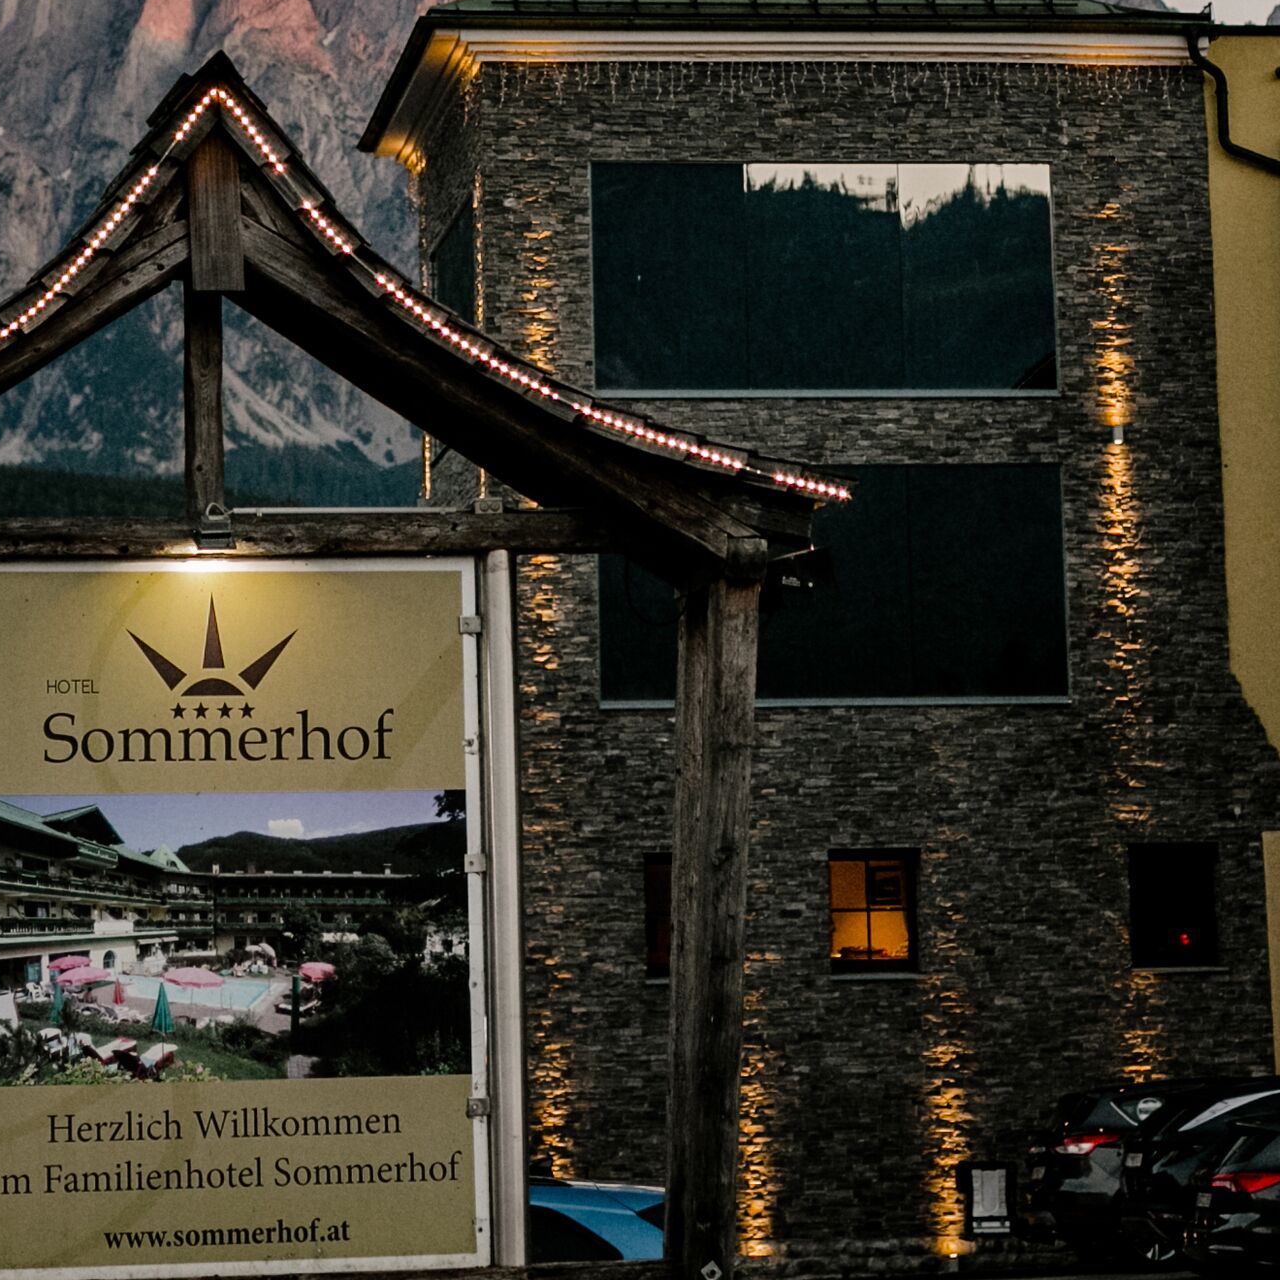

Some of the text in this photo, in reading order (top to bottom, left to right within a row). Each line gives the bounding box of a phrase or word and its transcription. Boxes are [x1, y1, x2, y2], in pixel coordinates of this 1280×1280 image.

[46, 679, 99, 695] HOTEL
[42, 708, 395, 764] Sommerhof
[47, 1107, 402, 1144] Herzlich Willkommen
[44, 1157, 263, 1194] Familienhotel
[274, 1151, 463, 1187] Sommerhof
[104, 1218, 350, 1249] www.sommerhof.at
